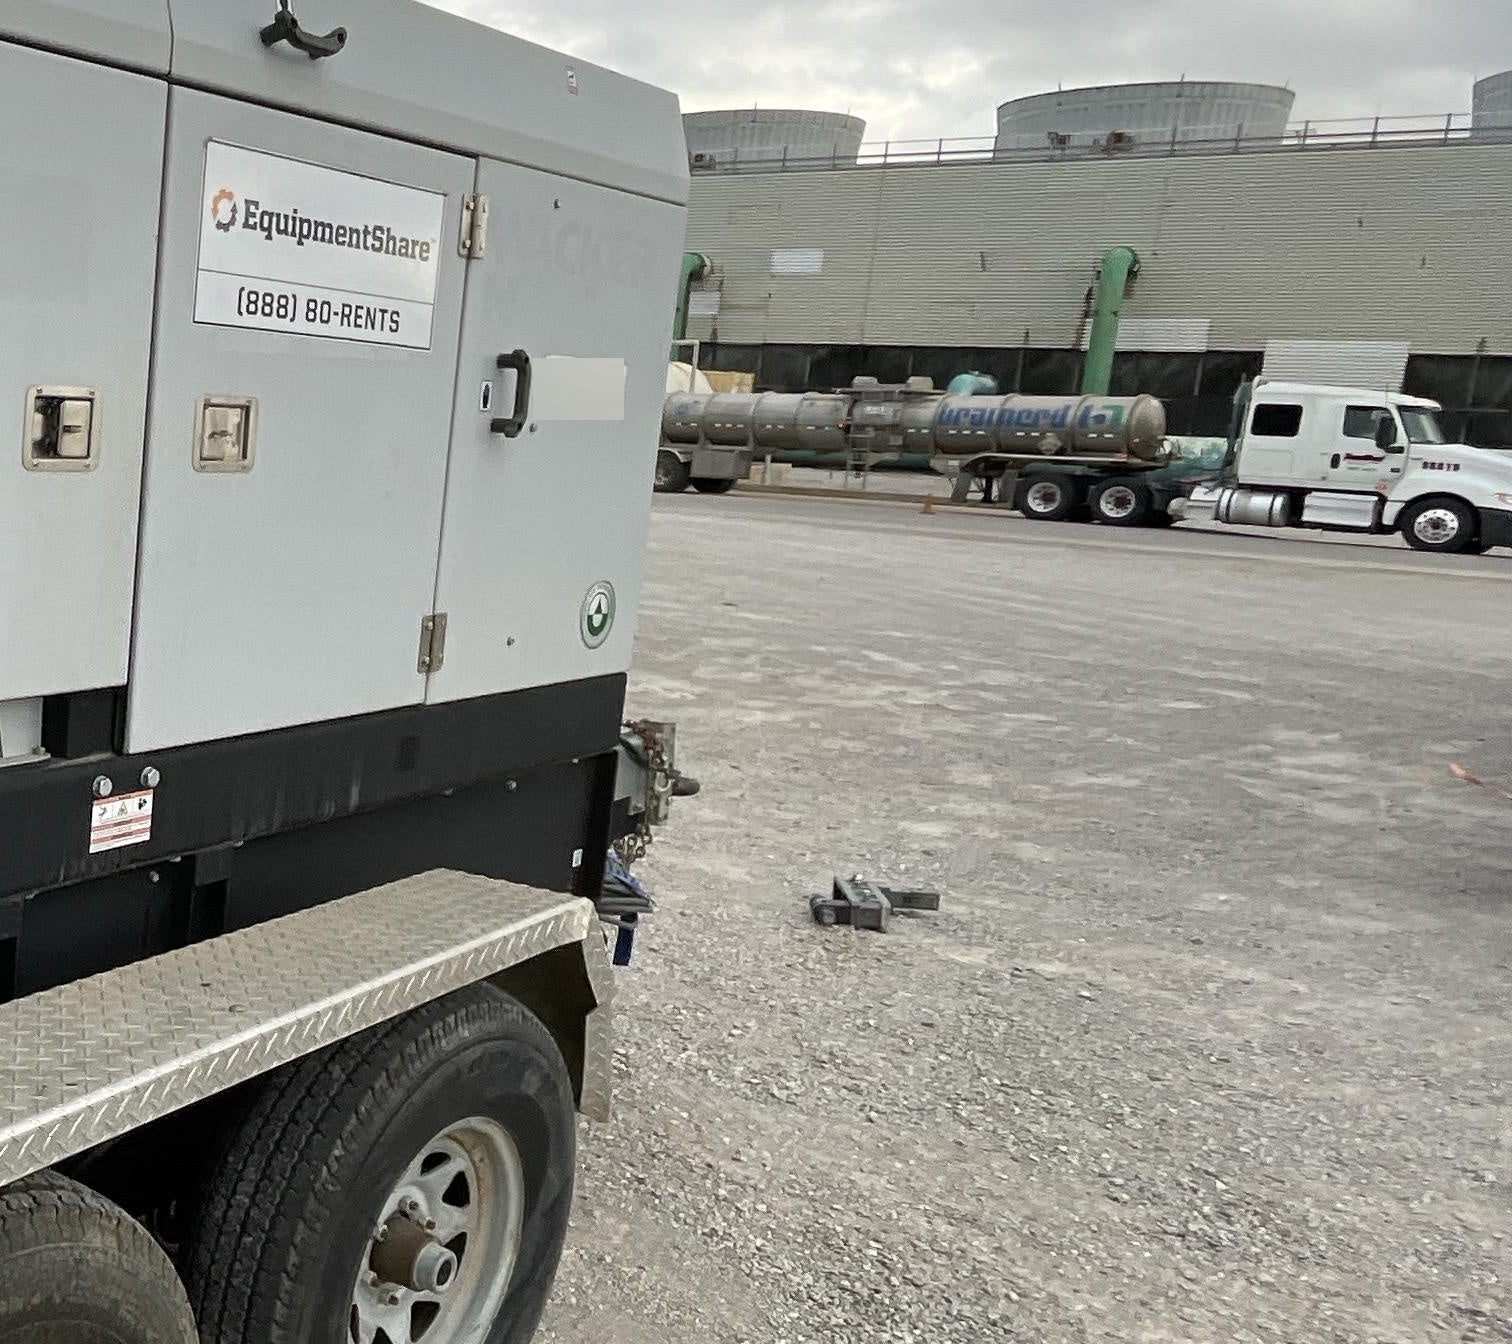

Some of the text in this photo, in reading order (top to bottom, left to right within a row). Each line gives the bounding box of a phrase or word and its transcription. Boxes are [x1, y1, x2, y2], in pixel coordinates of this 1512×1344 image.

[241, 198, 431, 262] EquipmentShare
[236, 286, 401, 334] (888) 80-RENTS
